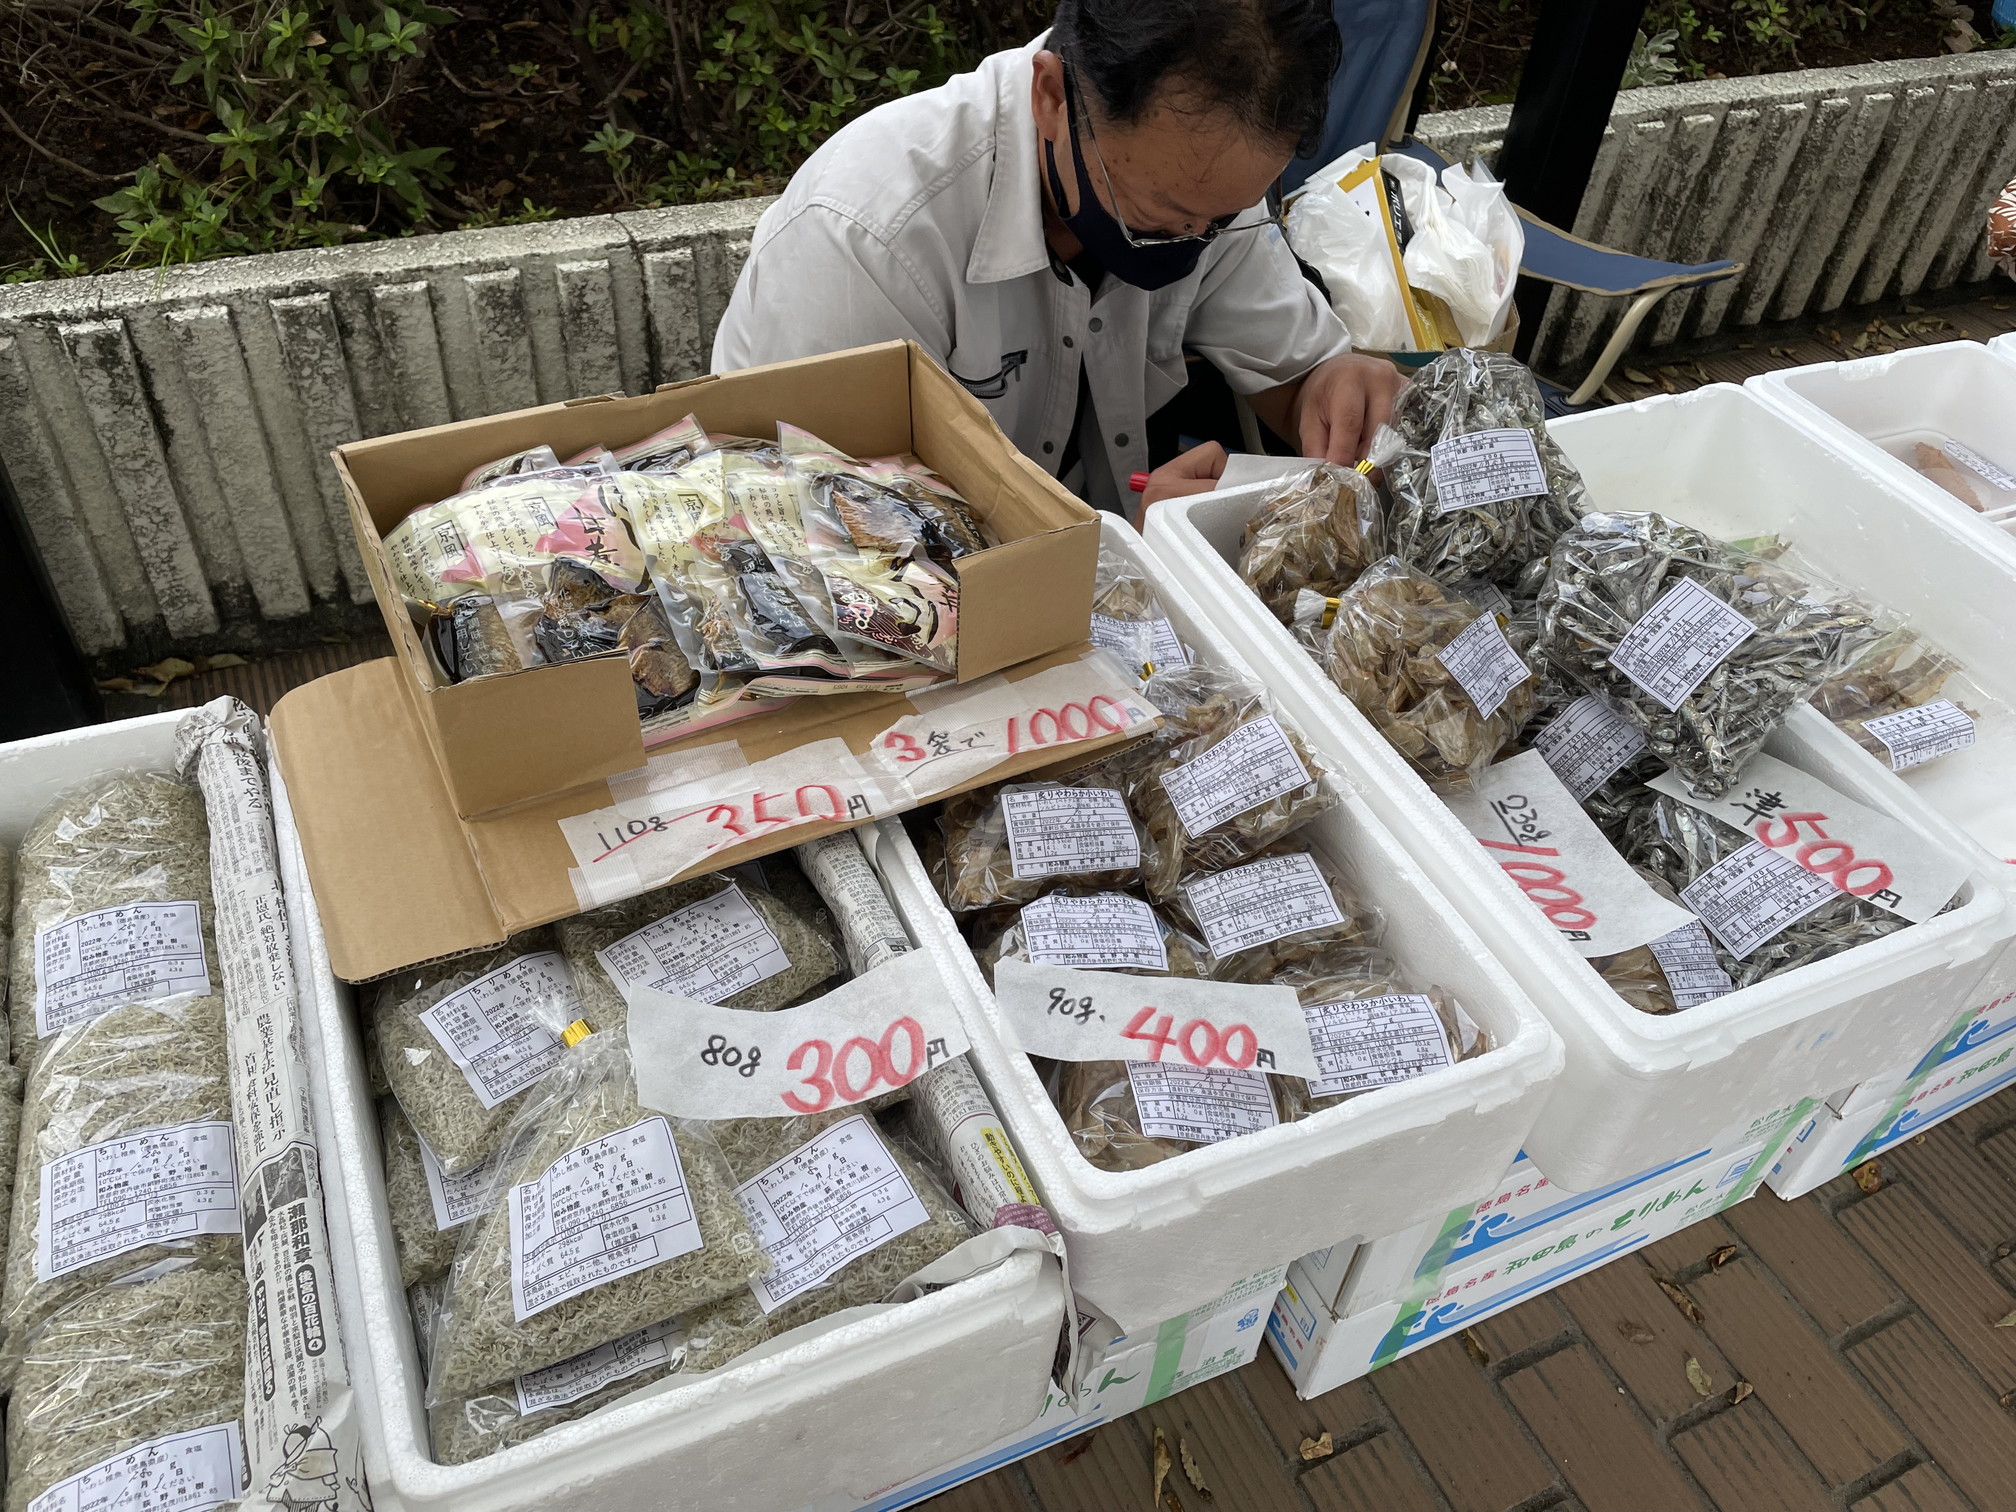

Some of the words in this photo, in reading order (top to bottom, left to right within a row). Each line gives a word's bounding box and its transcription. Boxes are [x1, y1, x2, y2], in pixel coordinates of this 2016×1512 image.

[527, 500, 555, 529] 京風
[438, 526, 462, 560] 京風
[1037, 790, 1113, 798] 炙りやわらか小いわし
[705, 784, 872, 850] 350円
[1217, 856, 1299, 883] 炙りやわらか小いわし
[1754, 811, 1903, 909] 500円
[1477, 837, 1598, 942] 1000円
[80, 906, 142, 927] ちりめん
[642, 907, 696, 937] ちりめん
[470, 961, 528, 996] ちりめん
[1322, 995, 1415, 1014] 炙りやわらか小いわし
[1118, 1005, 1278, 1071] 400円
[700, 1034, 763, 1078] 80g
[778, 1014, 950, 1115] 300円
[98, 1132, 170, 1157] ちりめん
[551, 1137, 609, 1174] ちりめん
[760, 1143, 819, 1187] ちりめん
[553, 1199, 581, 1219] 和み物産
[780, 1200, 808, 1222] 和み物産
[604, 1221, 639, 1242] 食塩相当量
[81, 1446, 159, 1485] ちりめん
